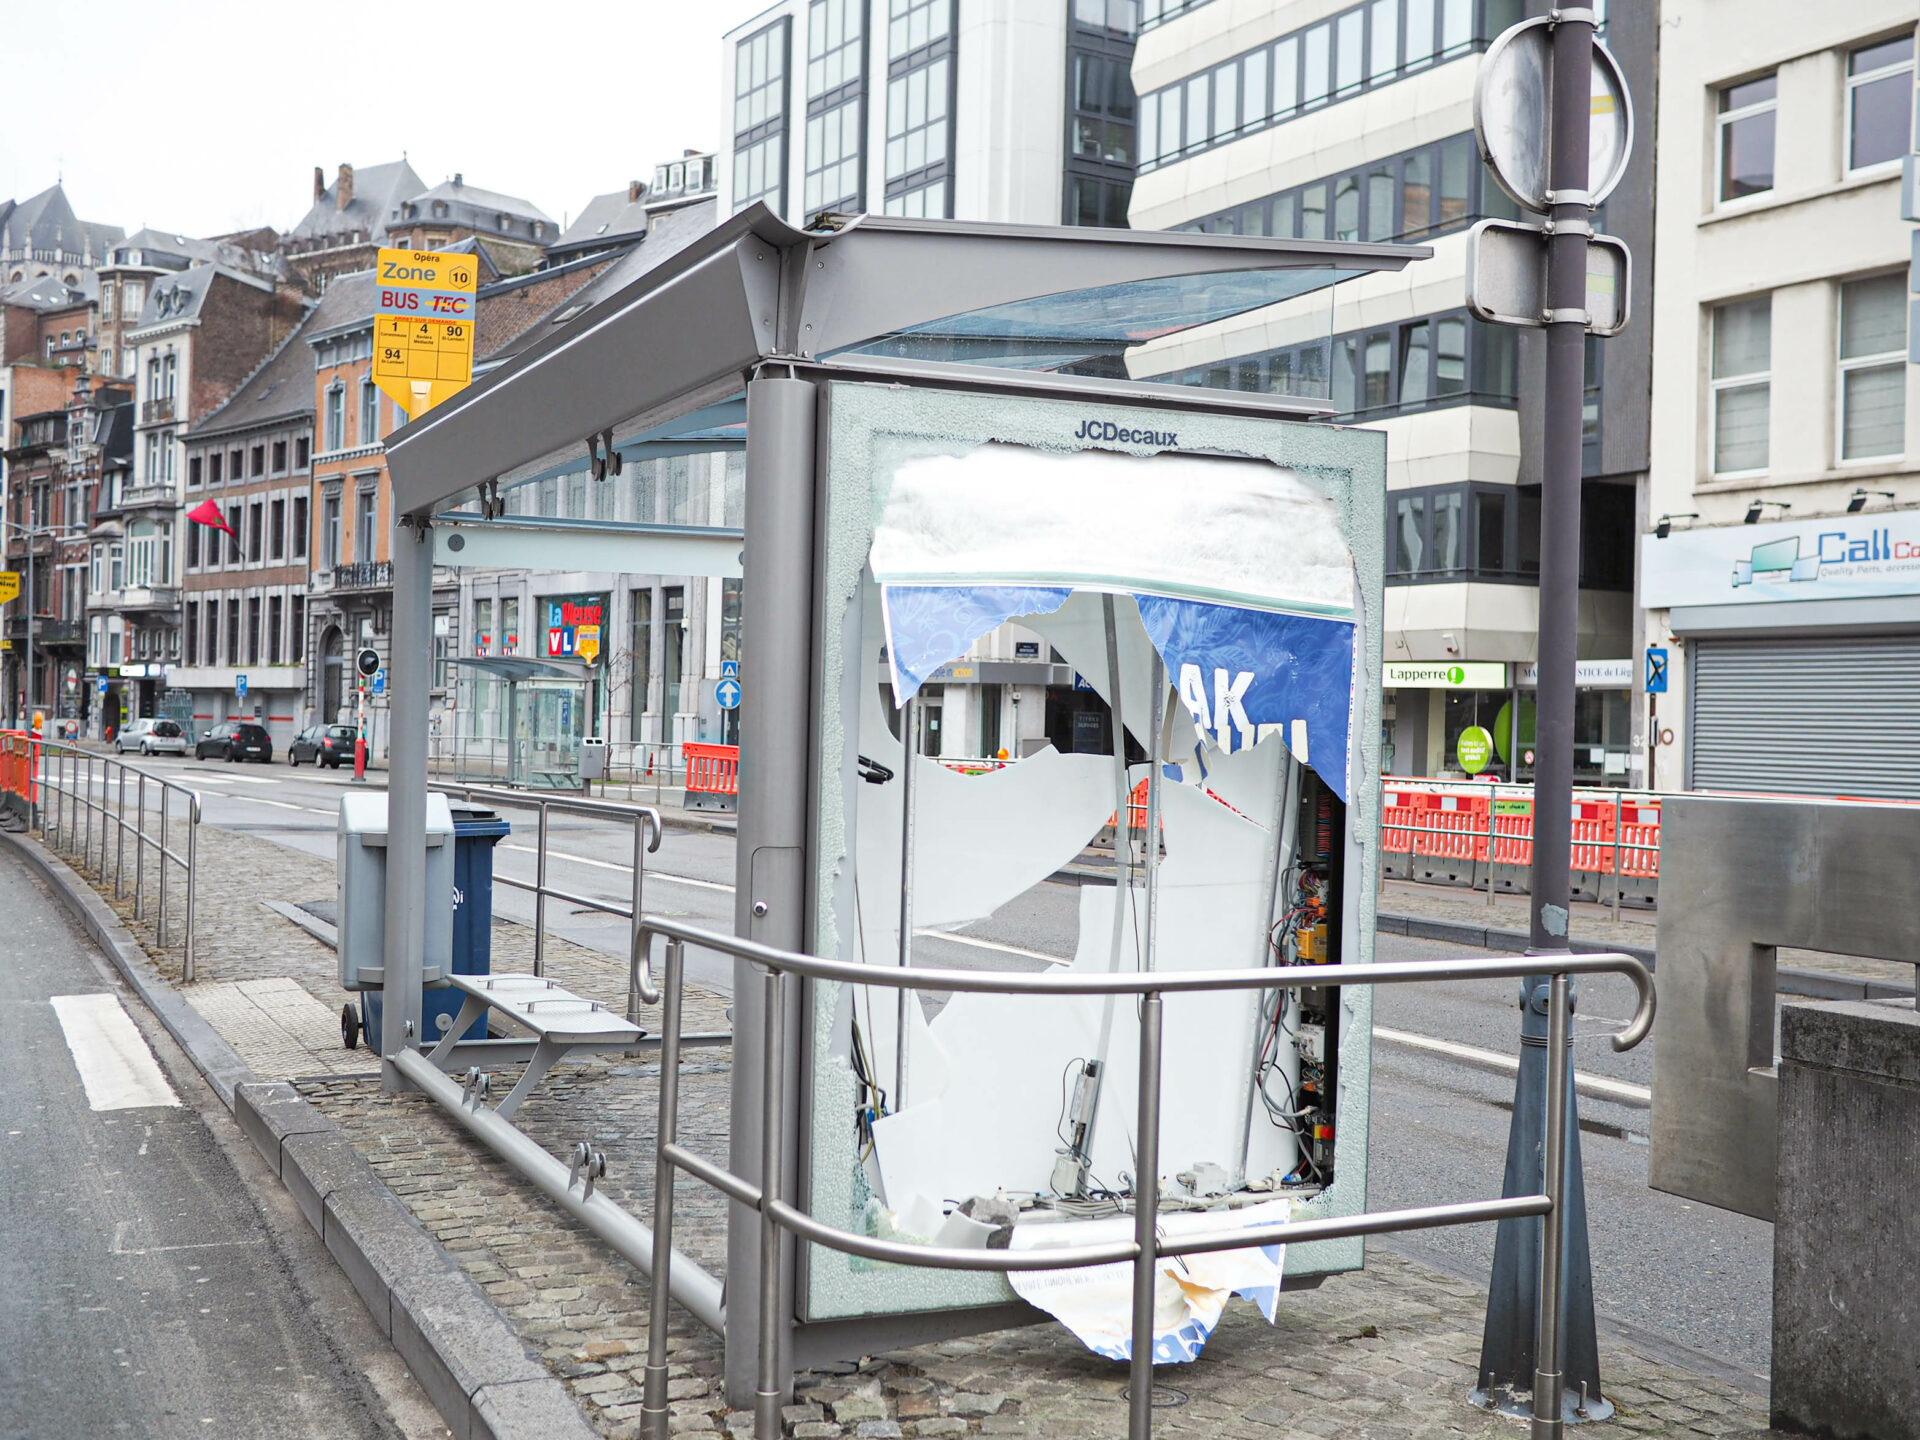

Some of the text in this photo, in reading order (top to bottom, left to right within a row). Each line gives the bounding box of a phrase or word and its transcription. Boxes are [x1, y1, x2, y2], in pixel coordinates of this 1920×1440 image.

[413, 252, 440, 263] Opéra
[383, 262, 468, 283] Zone 10
[381, 291, 467, 314] BUS TEC
[392, 322, 398, 332] 1
[420, 323, 428, 334] 4
[447, 326, 463, 337] 90
[385, 349, 401, 360] 94
[1074, 420, 1179, 447] JCDecaux
[1818, 528, 1890, 564] Call
[1390, 668, 1446, 682] Lapperre
[1577, 667, 1602, 677] STICE
